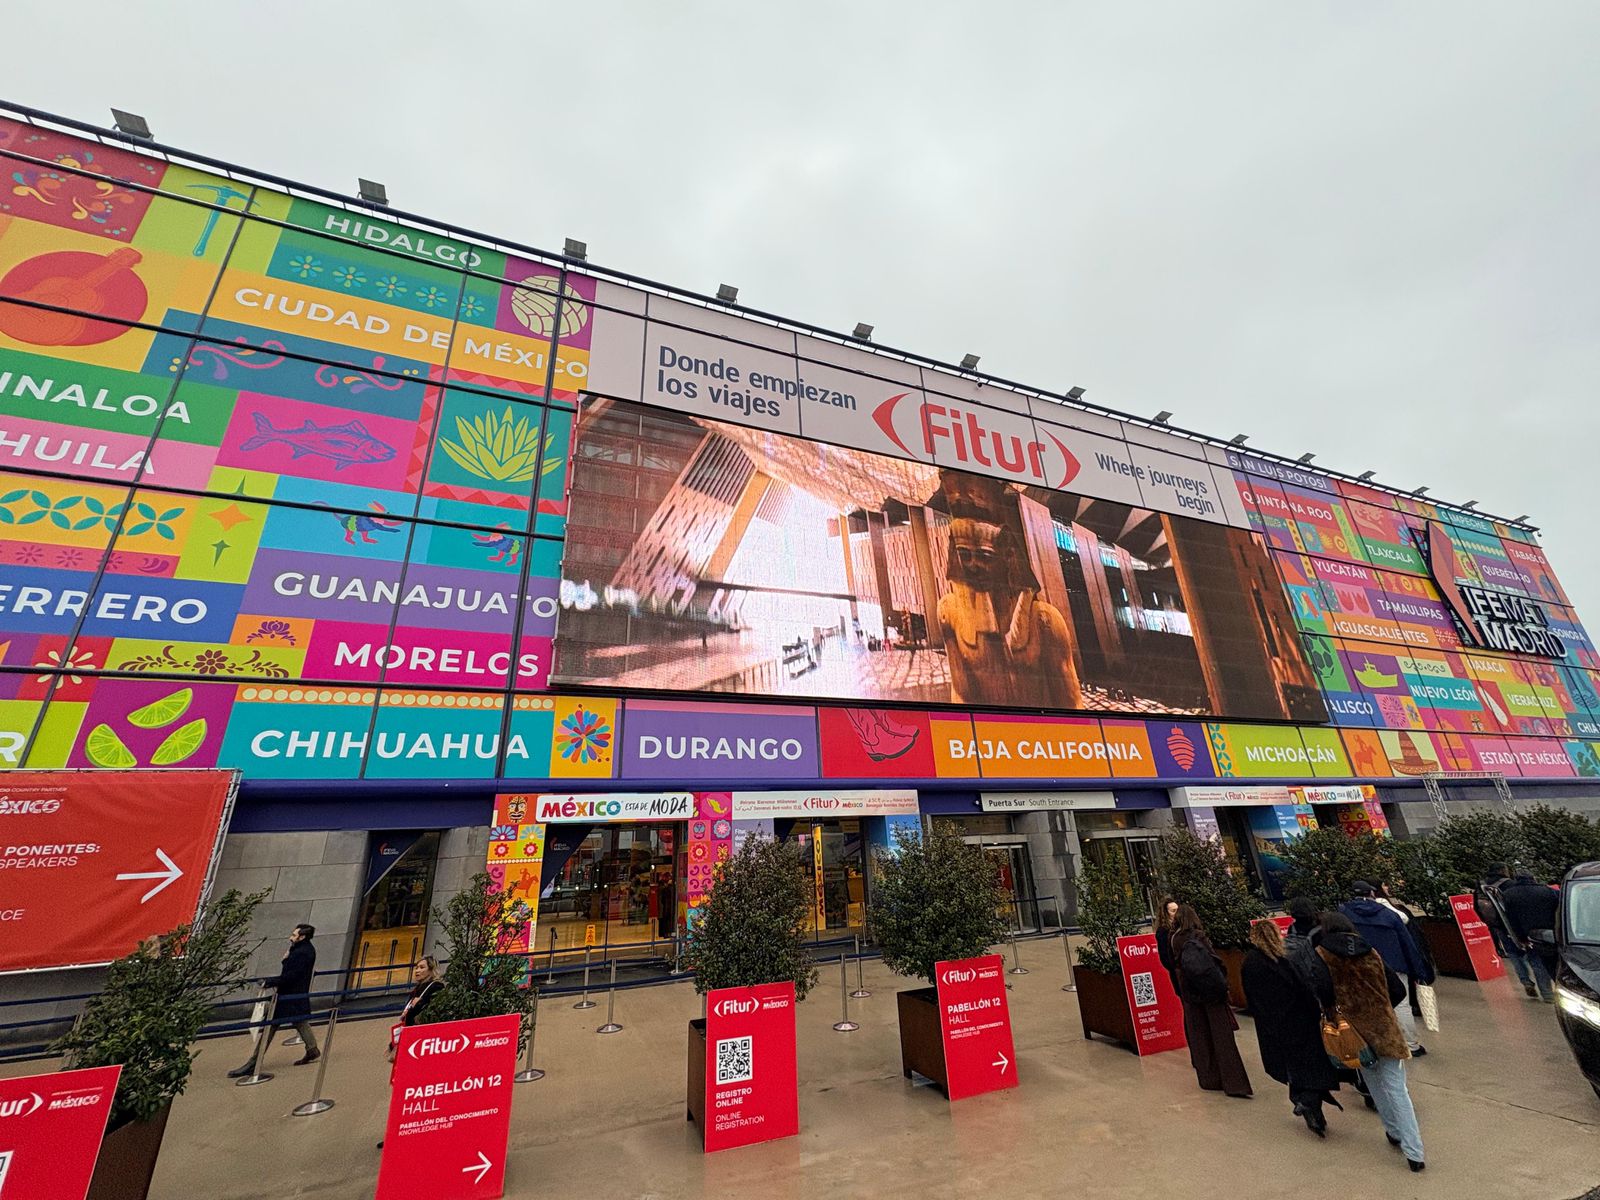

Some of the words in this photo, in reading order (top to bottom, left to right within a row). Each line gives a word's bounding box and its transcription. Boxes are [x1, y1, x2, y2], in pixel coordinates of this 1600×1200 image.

[324, 214, 483, 268] HIDALGO
[234, 287, 391, 336] CIUDAD
[402, 323, 451, 350] DE
[463, 337, 588, 379] MÉXICO
[659, 345, 740, 383] Donde
[749, 370, 857, 411] empiezan
[657, 369, 698, 399] los
[708, 384, 781, 417] viajes
[919, 402, 1046, 479] Fitur
[1095, 452, 1145, 480] Where
[1147, 465, 1208, 495] journeys
[1257, 462, 1284, 479] LUIS
[1286, 472, 1327, 489] POTOSÍ
[1176, 489, 1215, 514] begin
[1242, 491, 1304, 514] QUINTANA
[1307, 507, 1333, 521] ROO
[1365, 544, 1415, 565] TLAXCALA
[1509, 549, 1546, 565] TABASCO
[1314, 560, 1368, 580] YUCATÁN
[1482, 565, 1531, 583] QUERÉTARO
[1377, 599, 1444, 620] TAMAULIPAS
[1461, 586, 1541, 625] IFEMA
[1333, 621, 1429, 644] AGUASCALIENTES
[1477, 618, 1568, 658] MADRID
[1553, 627, 1587, 642] SONORA
[334, 641, 540, 678] MORELOS
[1410, 684, 1448, 700] NUEVO
[1450, 686, 1479, 702] LEÓN
[250, 729, 530, 760] CHIHUAHUA
[638, 735, 802, 760] DURANGO
[948, 738, 1008, 760] BAJA
[1017, 739, 1142, 761] CALIFORNIA
[1245, 743, 1338, 764] MICHOACÁN
[1479, 751, 1520, 765] ESTADO
[1521, 752, 1537, 765] DE
[1537, 750, 1571, 765] MÉXICO
[649, 796, 688, 815] MODA
[1013, 799, 1026, 807] Sur
[1028, 799, 1047, 807] South
[1048, 799, 1074, 807] Entrance
[5, 843, 101, 856] PONENTES:
[949, 970, 970, 983] Fitur
[723, 999, 751, 1015] Fitur
[947, 998, 991, 1014] PABELLÓN
[992, 997, 1001, 1006] 12
[948, 1013, 970, 1025] HALL
[420, 1036, 459, 1057] Fitur
[404, 1076, 484, 1100] PABELLÓN
[487, 1074, 502, 1087] 12
[716, 1086, 752, 1100] REGISTRO
[402, 1098, 440, 1116] HALL
[715, 1096, 743, 1108] ONLINE
[399, 1117, 435, 1130] PABELLÓN
[435, 1116, 448, 1124] DEL
[449, 1107, 499, 1121] CONOCIMIENTO
[715, 1110, 741, 1122] ONLINE
[715, 1115, 764, 1131] REGISTRATION
[398, 1123, 439, 1137] KNOWLEDGE
[439, 1121, 453, 1129] HUB
